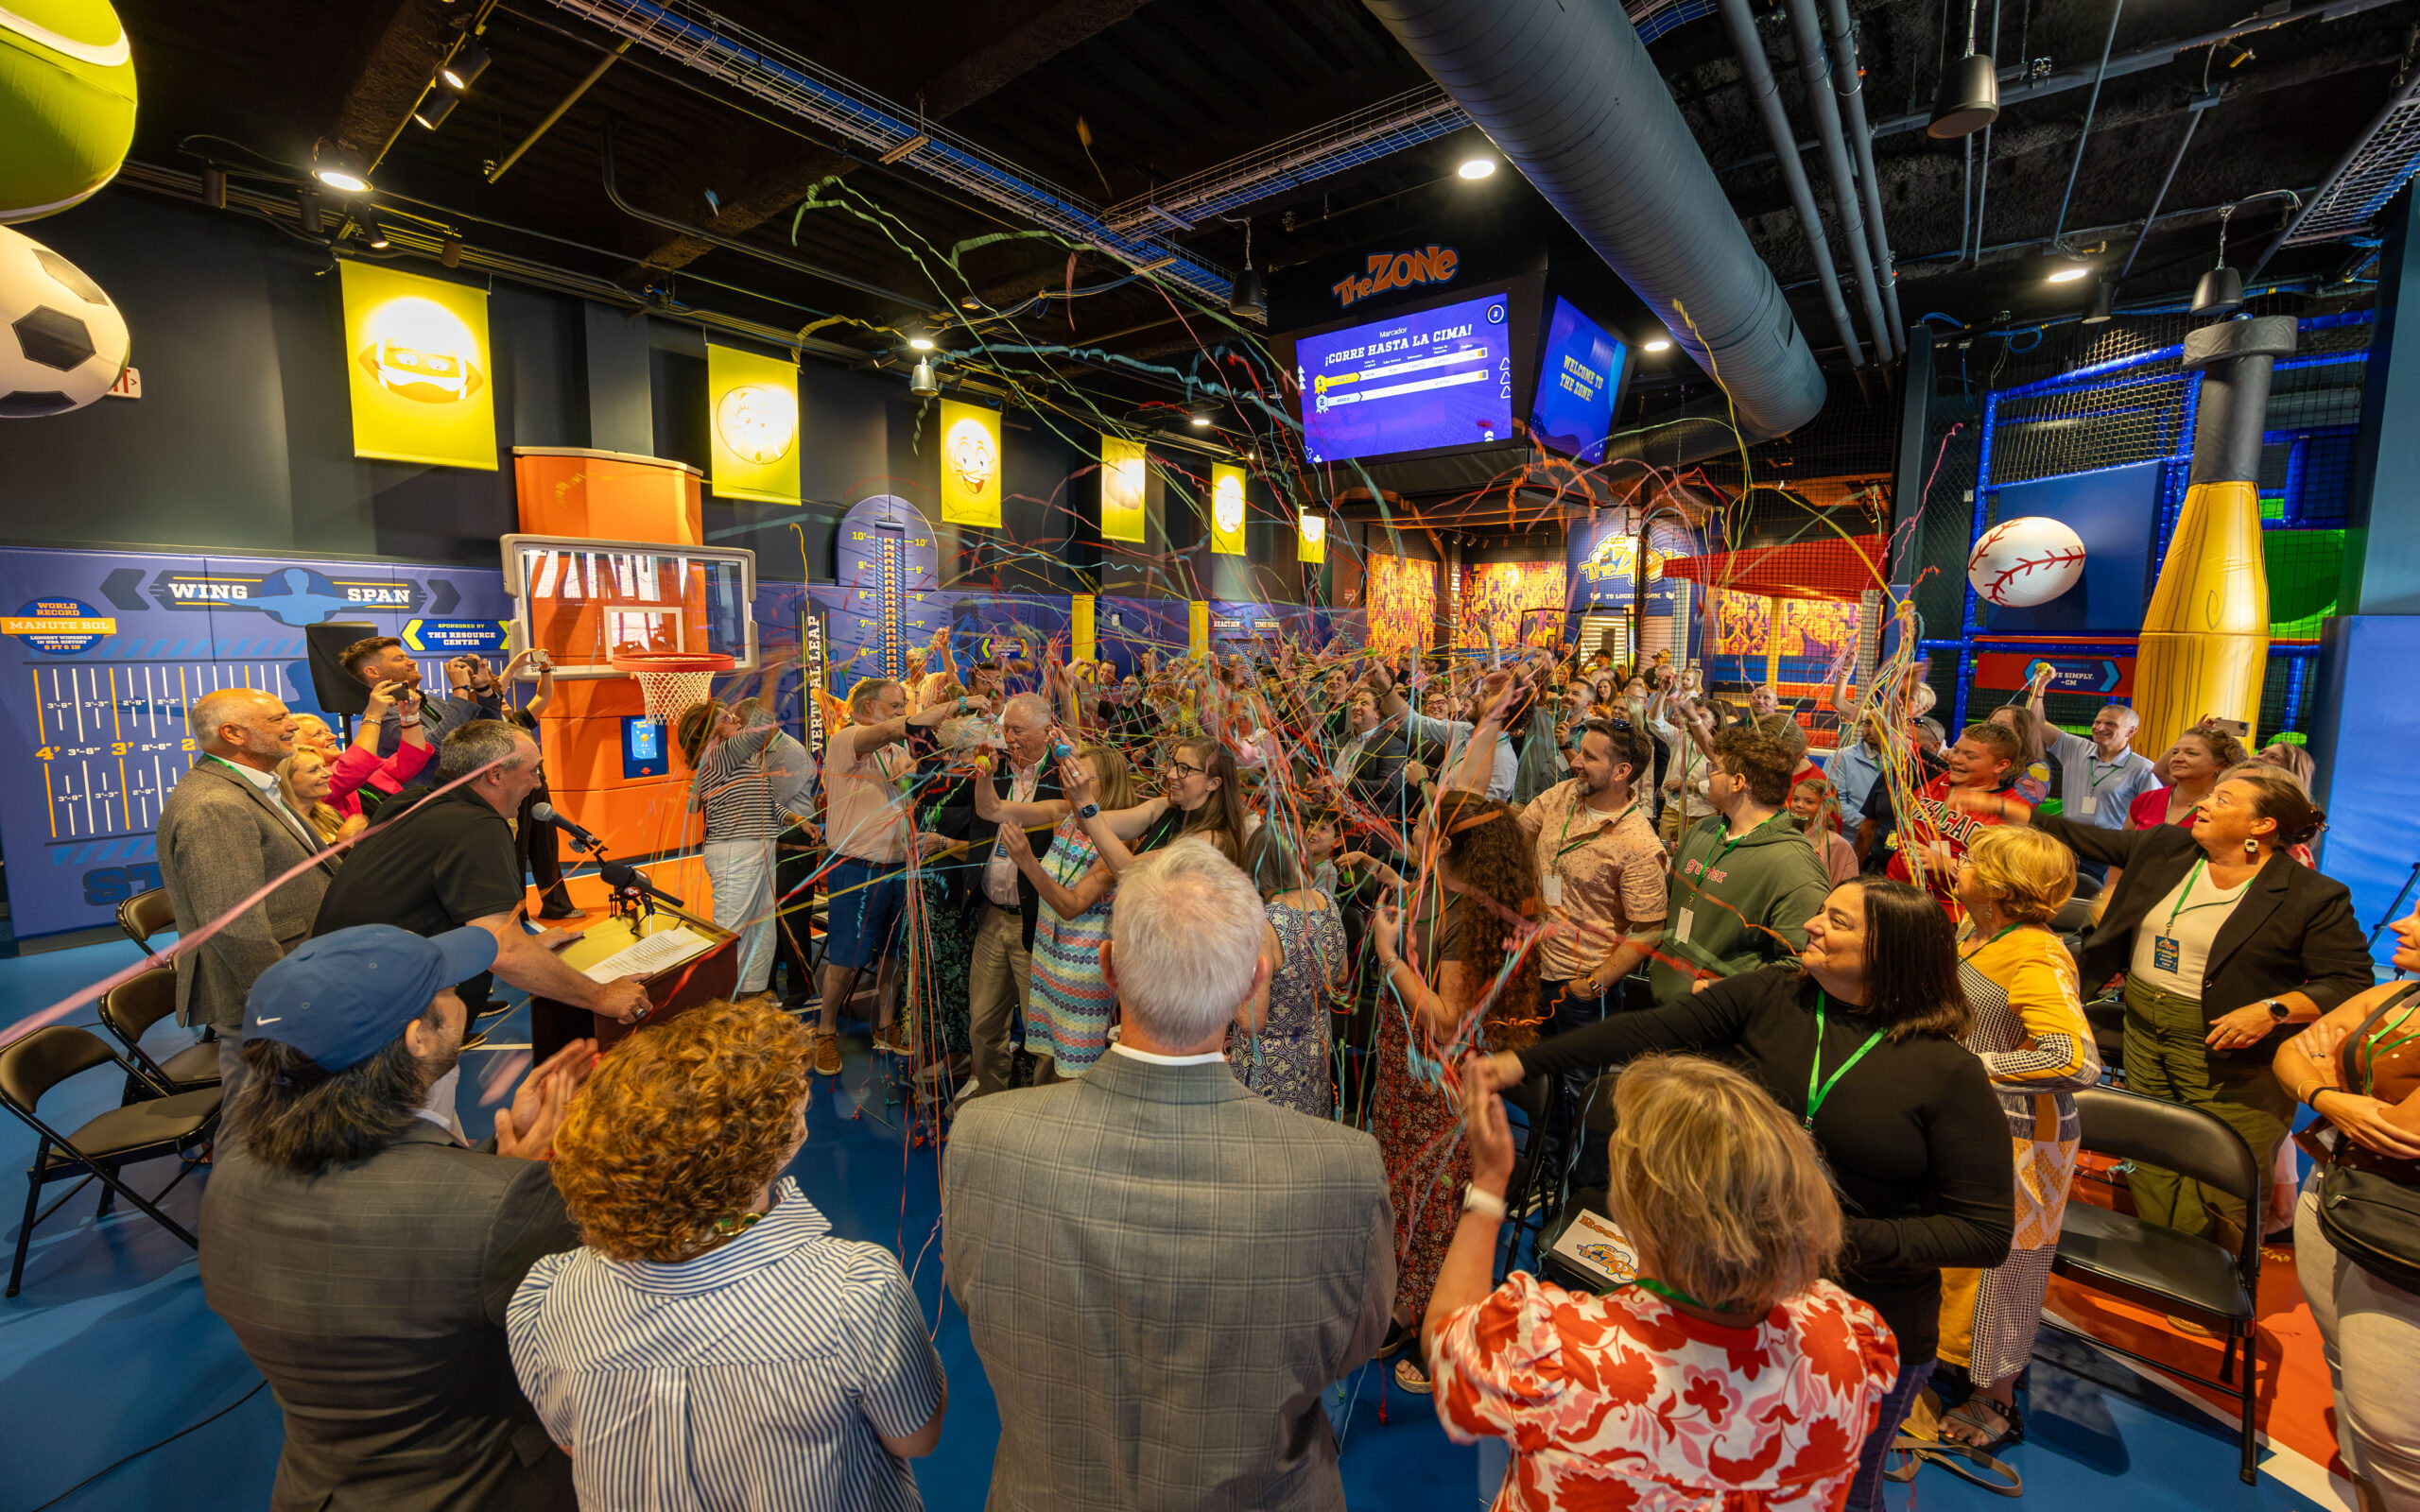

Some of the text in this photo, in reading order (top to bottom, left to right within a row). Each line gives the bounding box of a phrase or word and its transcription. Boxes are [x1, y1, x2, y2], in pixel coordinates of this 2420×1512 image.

[1333, 274, 1373, 306] The
[1380, 327, 1408, 338] Marcador
[1325, 324, 1473, 367] ¡CORRE HASTA LA CIMA!
[1564, 354, 1604, 389] WELCOME TO
[1560, 372, 1594, 403] THE ZONE!
[852, 531, 867, 541] 10'
[915, 539, 928, 547] 10'
[168, 583, 248, 599] WING
[347, 588, 410, 603] SPAN
[9, 621, 110, 629] MANUTE BOL
[859, 619, 869, 627] 7'
[917, 620, 925, 628] 7'
[807, 615, 823, 753] VERTAL LEAP
[112, 742, 134, 756] 3'
[182, 738, 197, 751] 2
[35, 746, 60, 761] 4'
